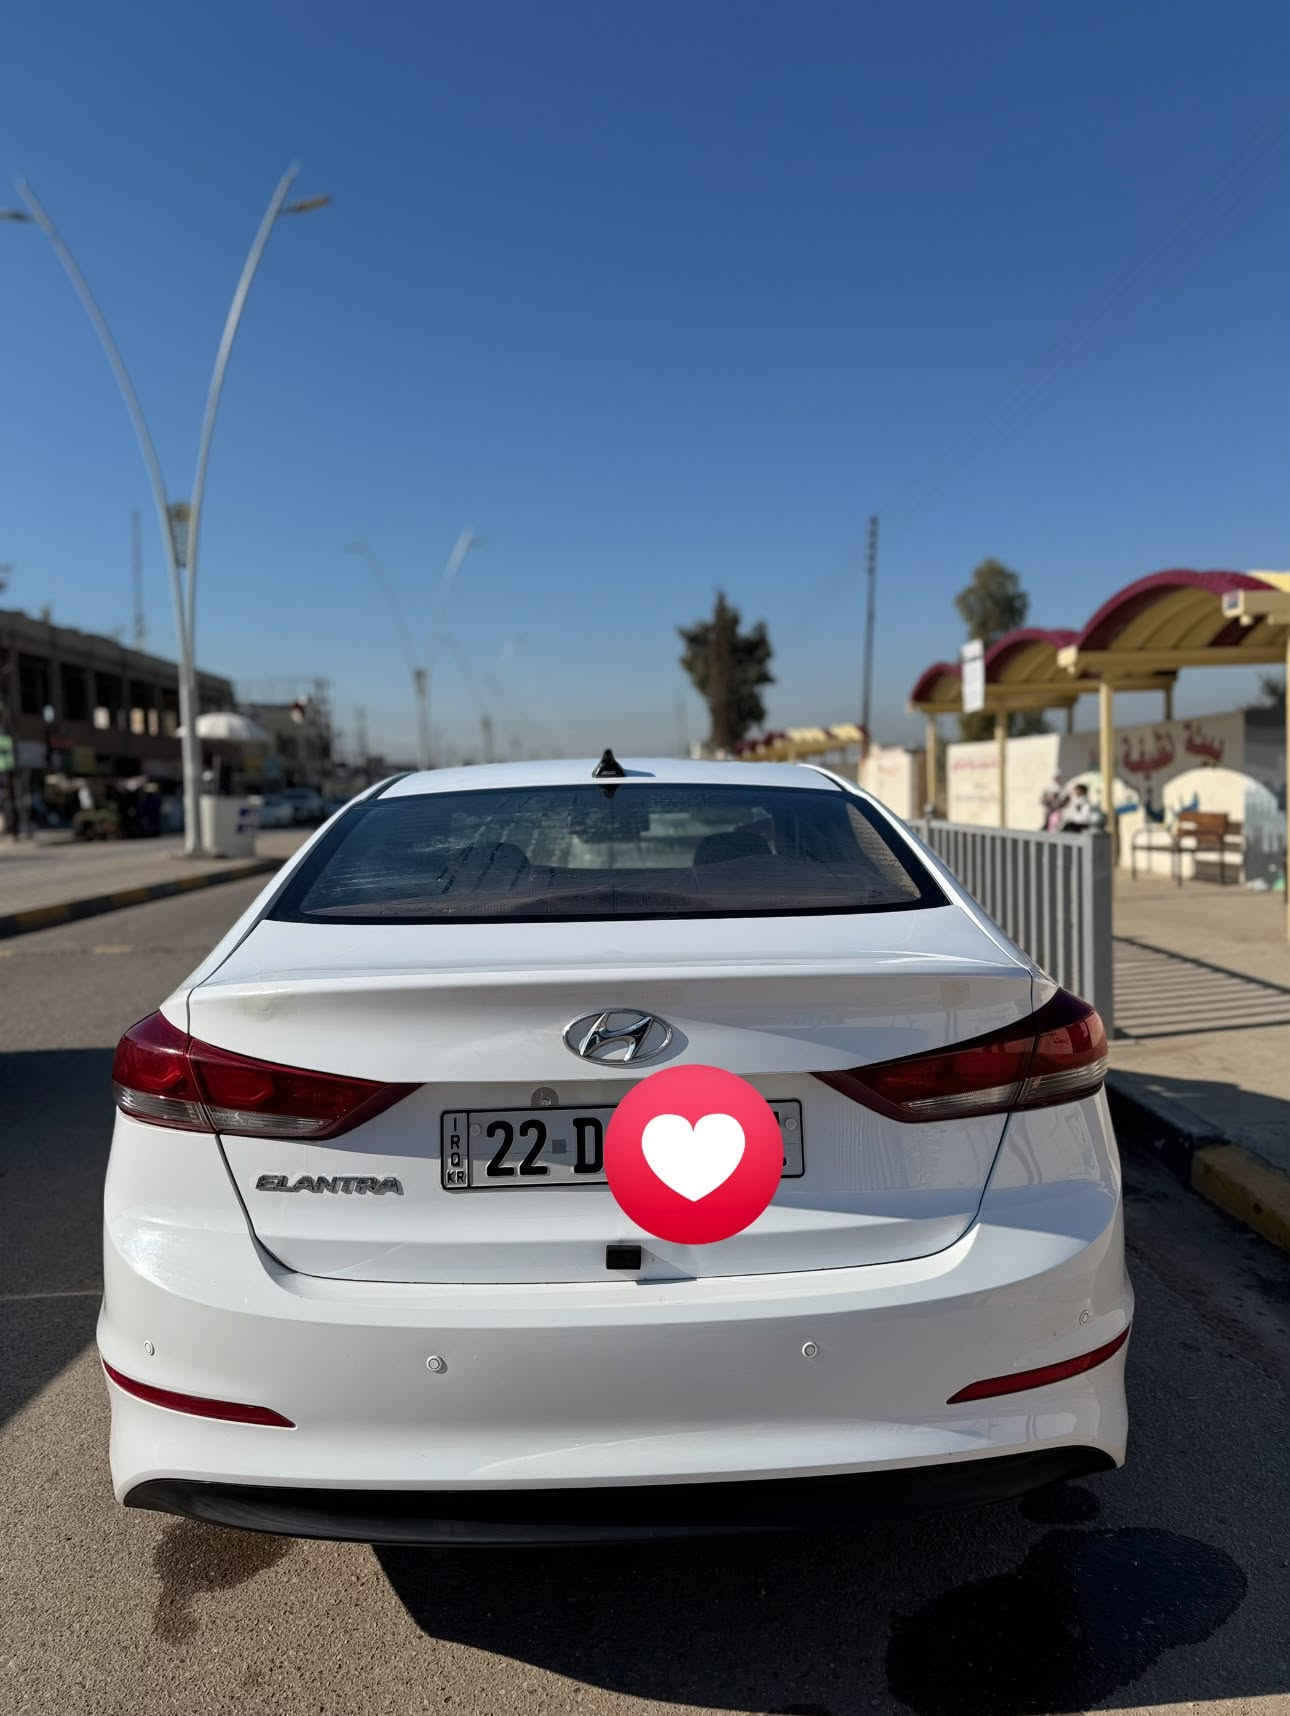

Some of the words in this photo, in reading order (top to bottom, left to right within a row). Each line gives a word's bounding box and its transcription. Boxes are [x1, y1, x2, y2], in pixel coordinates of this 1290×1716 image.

[450, 1116, 461, 1168] IRQ
[486, 1119, 548, 1176] 22
[572, 1116, 603, 1174] D
[256, 1174, 404, 1195] ELANTRA
[446, 1169, 465, 1185] KR
